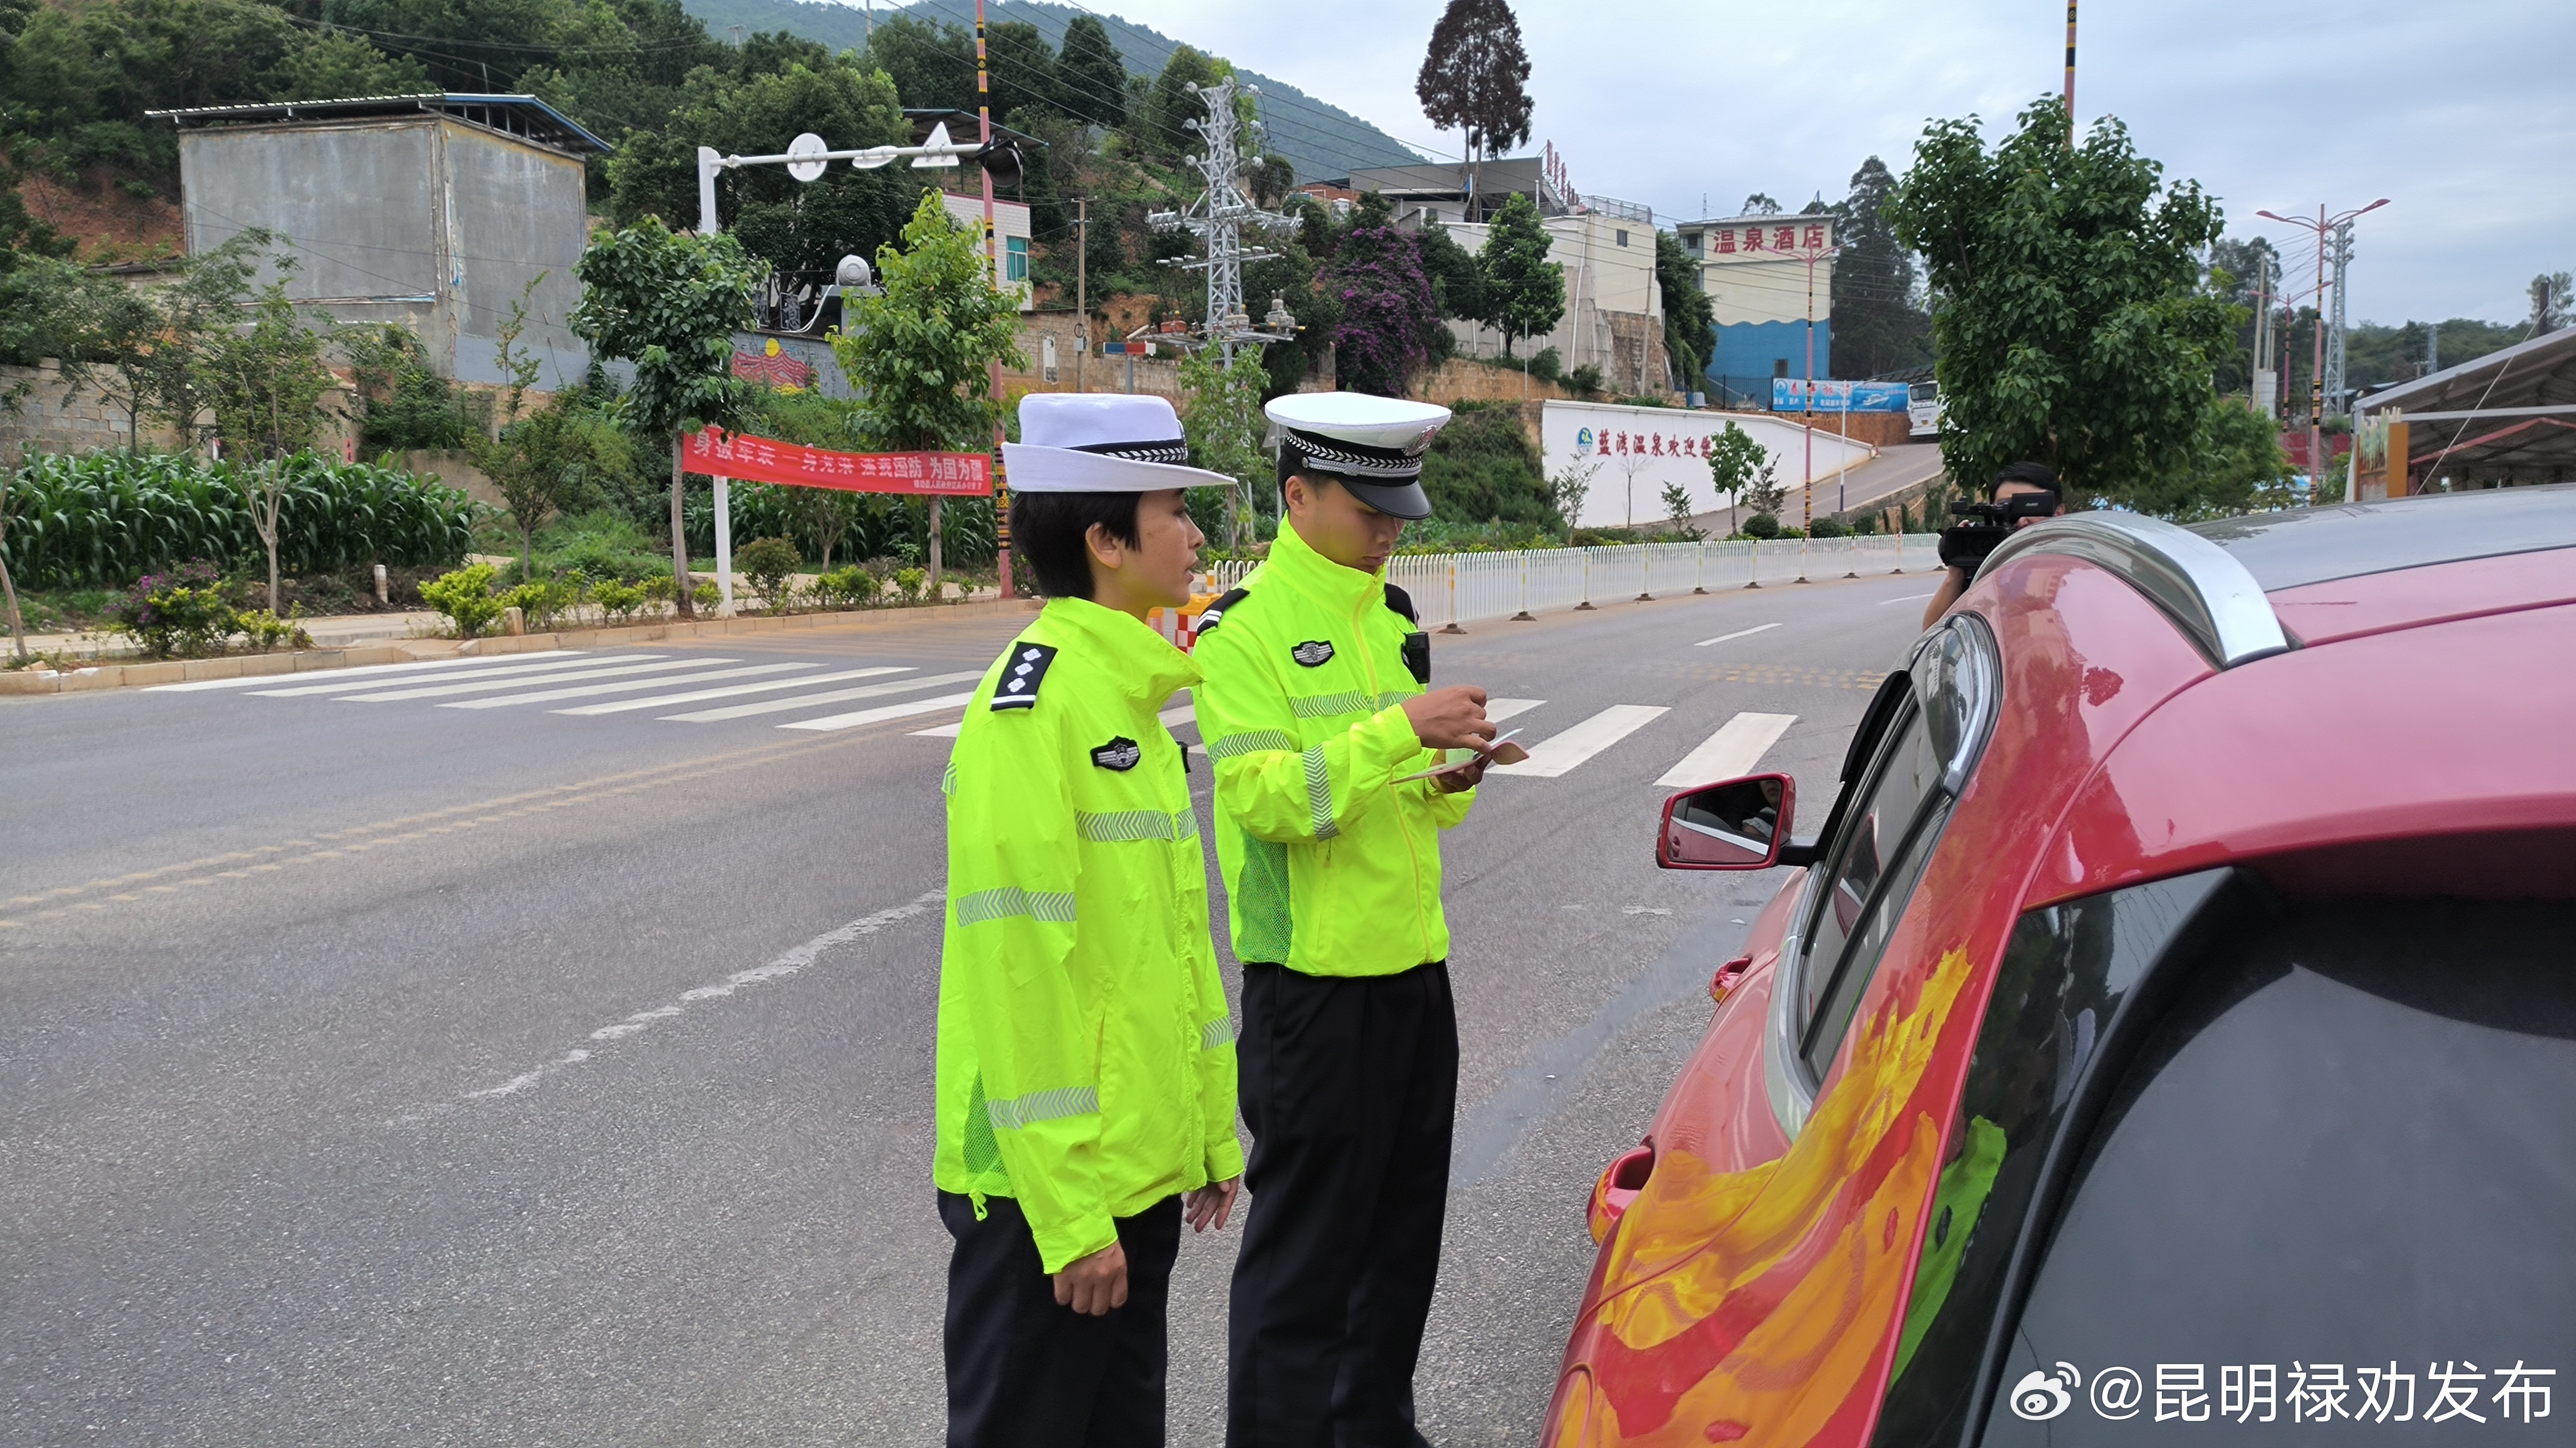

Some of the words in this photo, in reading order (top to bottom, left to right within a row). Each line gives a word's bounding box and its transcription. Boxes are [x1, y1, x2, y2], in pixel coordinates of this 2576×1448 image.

[1713, 223, 1825, 254] 温泉酒店
[1597, 428, 1712, 460] 蓝湾温泉欢迎您
